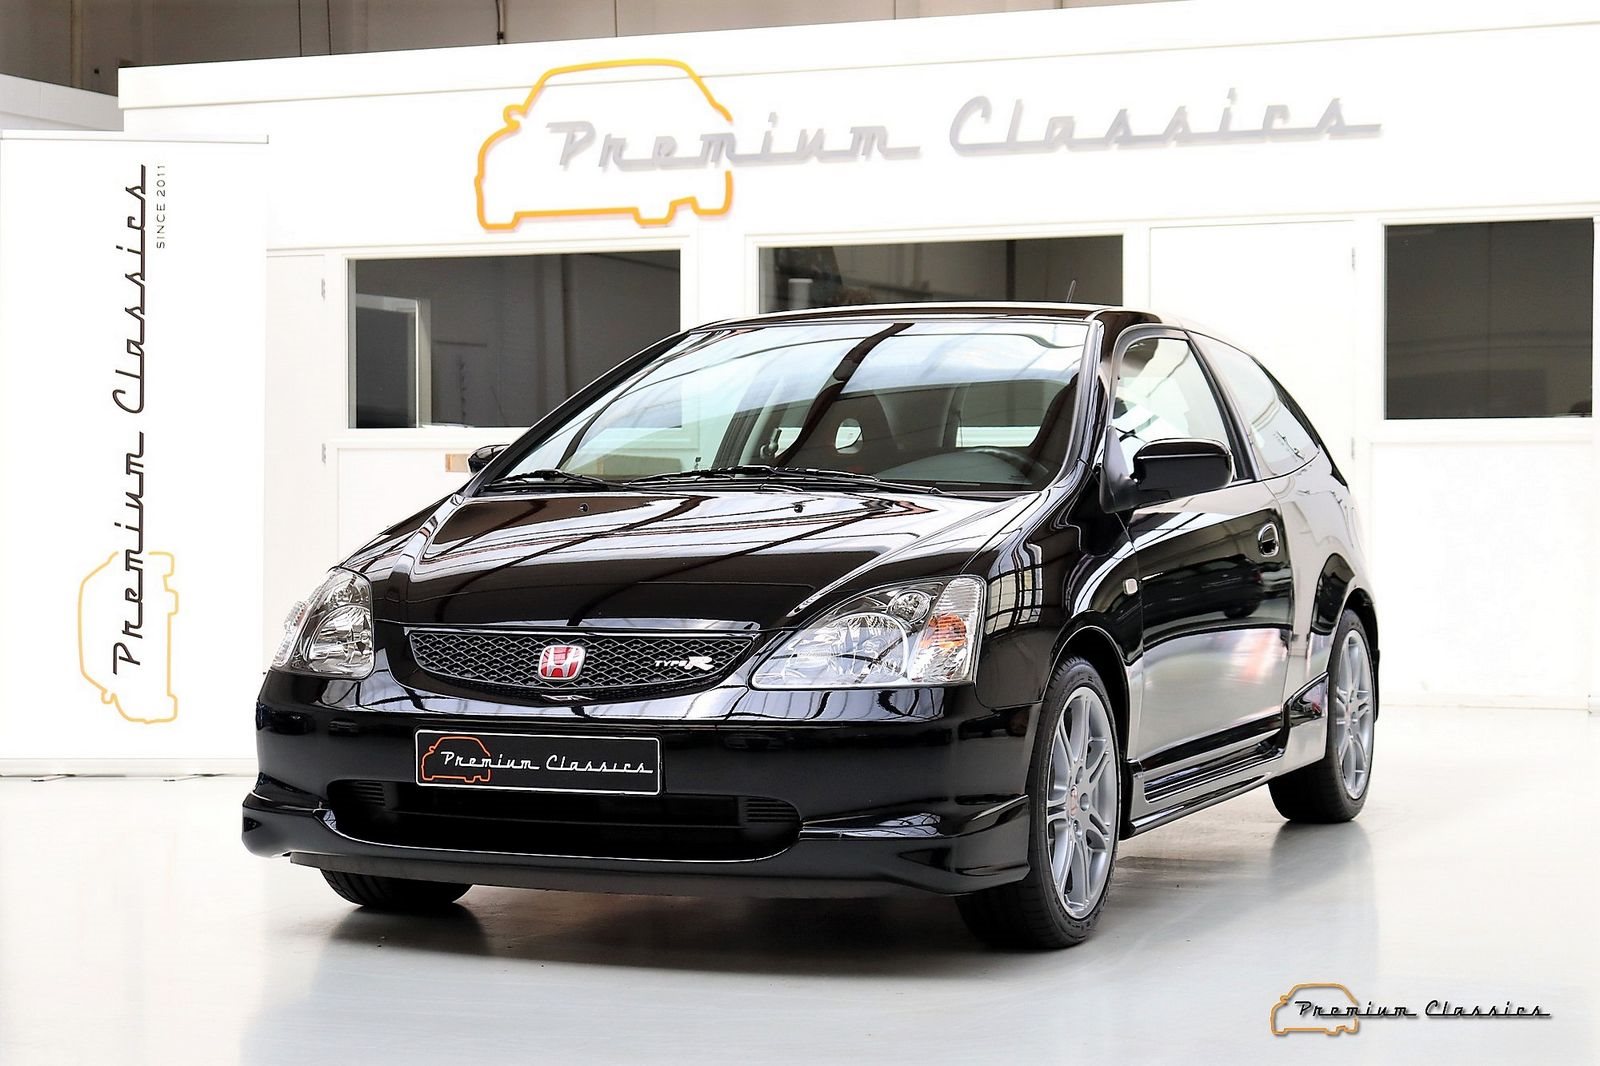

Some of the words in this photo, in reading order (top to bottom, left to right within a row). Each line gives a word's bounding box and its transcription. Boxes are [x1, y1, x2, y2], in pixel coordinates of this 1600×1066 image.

[546, 111, 921, 171] Premium
[949, 87, 1382, 157] Classics
[156, 165, 166, 197] 2011
[156, 203, 166, 249] SINCE
[112, 164, 146, 414] Classics
[112, 431, 145, 675] Premium
[440, 751, 540, 770] Premium
[545, 754, 654, 774] Classics
